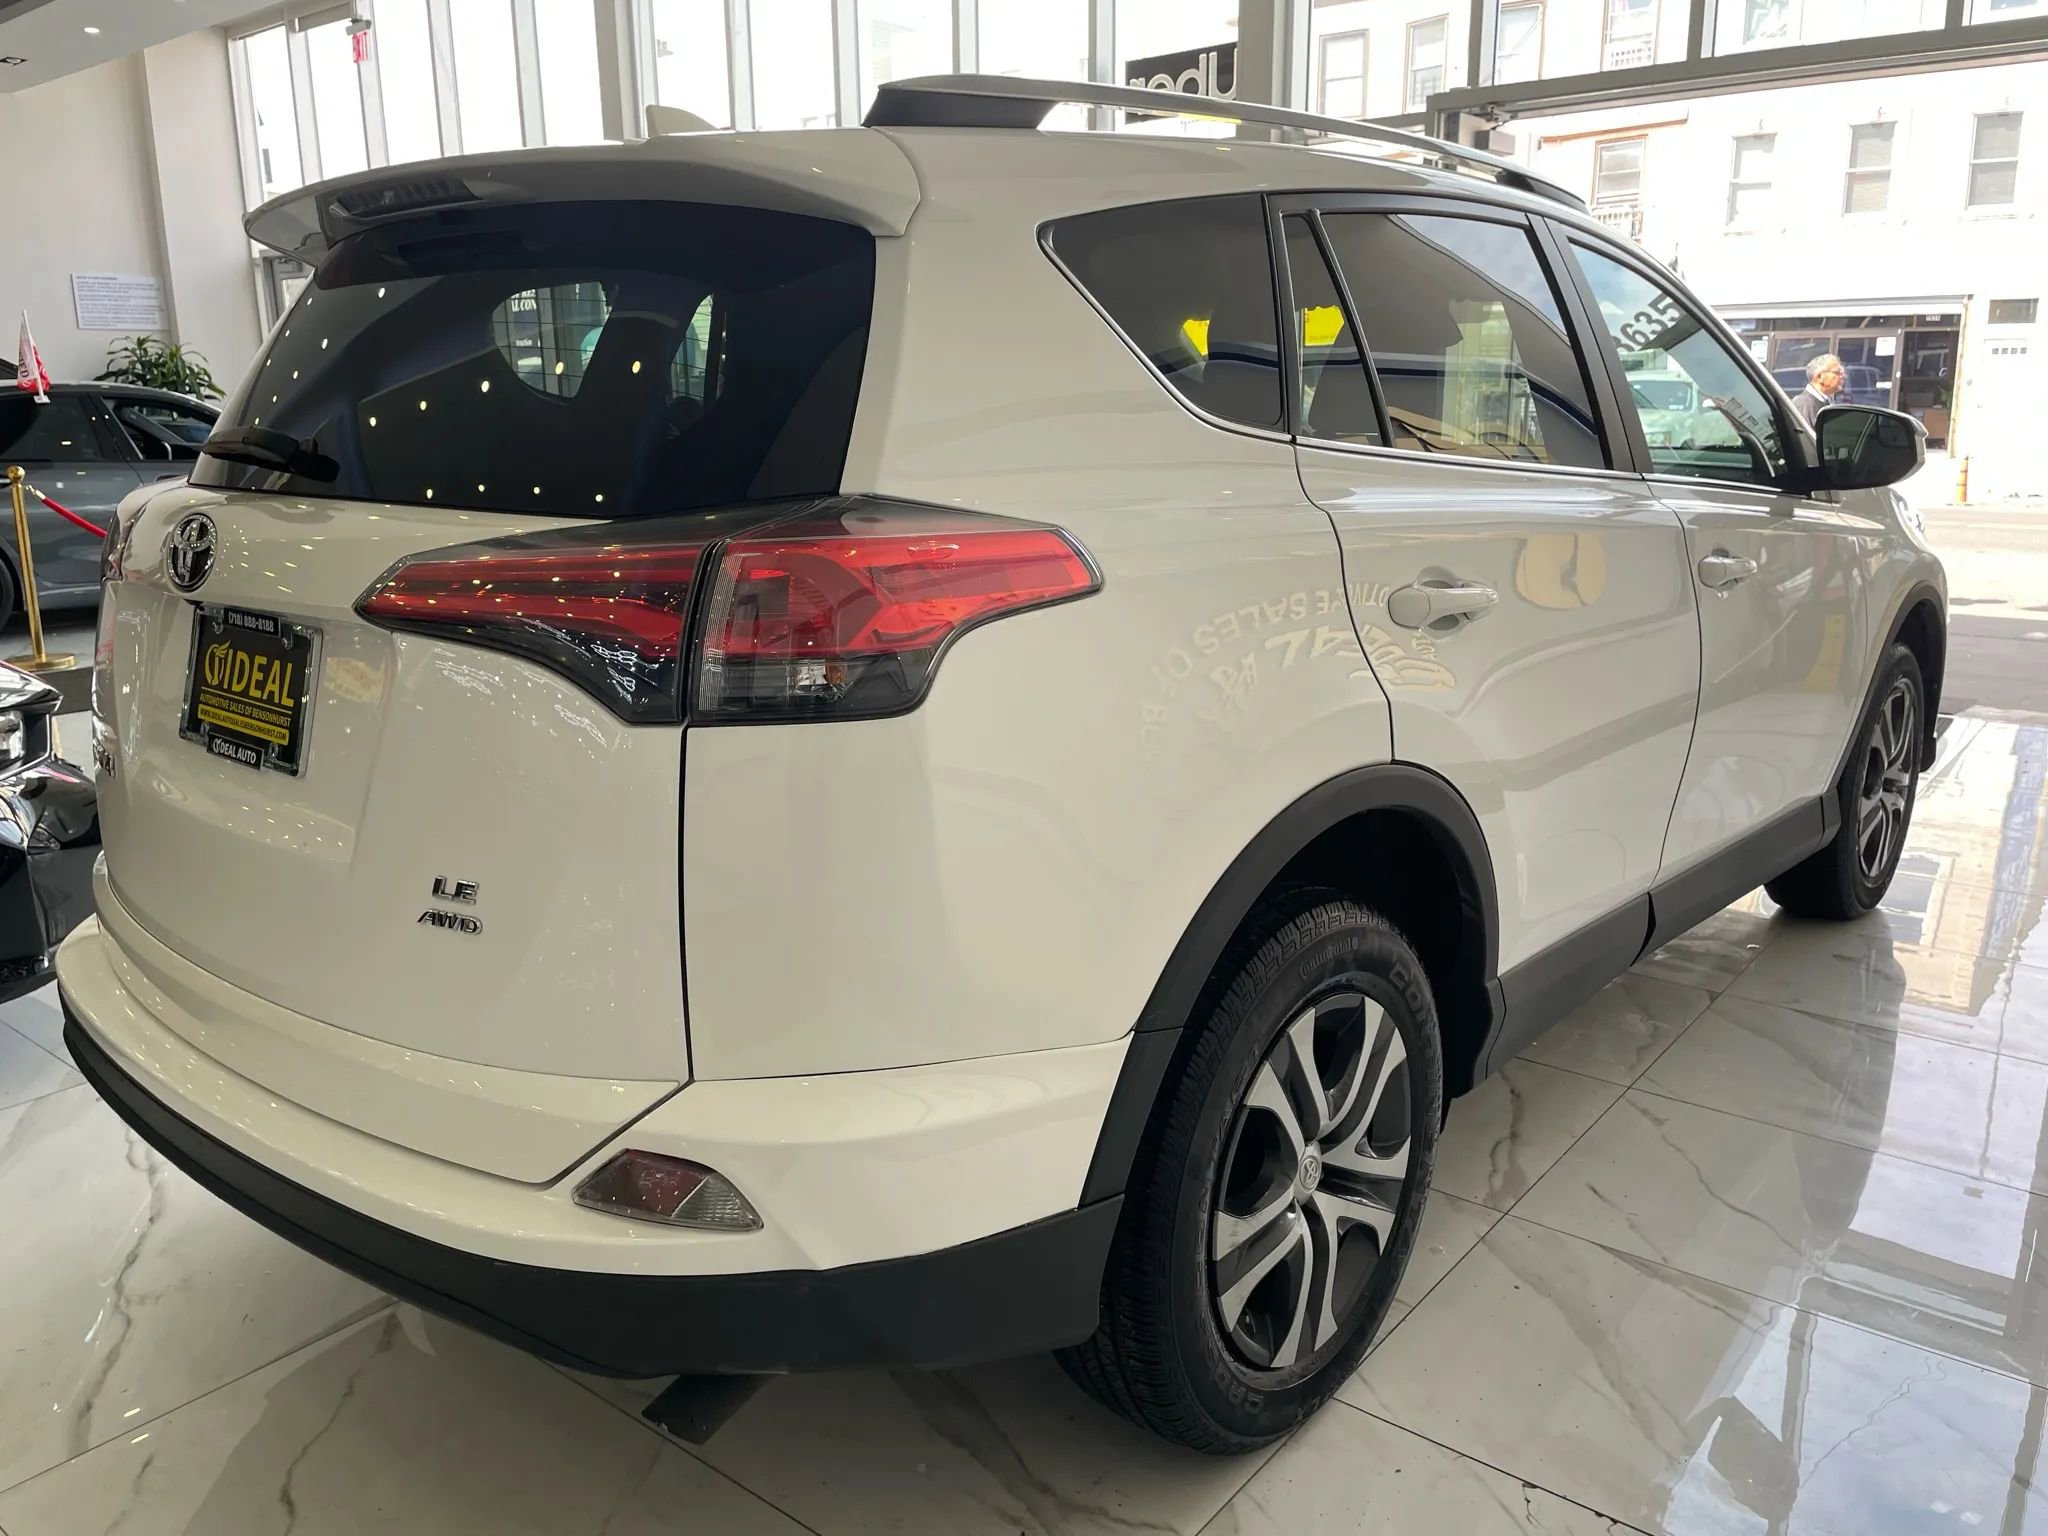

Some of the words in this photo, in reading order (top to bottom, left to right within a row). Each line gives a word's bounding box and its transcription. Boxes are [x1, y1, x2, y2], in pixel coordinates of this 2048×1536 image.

[222, 648, 295, 707] IDEAL
[229, 700, 246, 715] SALES
[245, 706, 252, 716] OF
[237, 746, 257, 764] AUTO
[431, 875, 479, 906] LE
[416, 908, 484, 936] AWD
